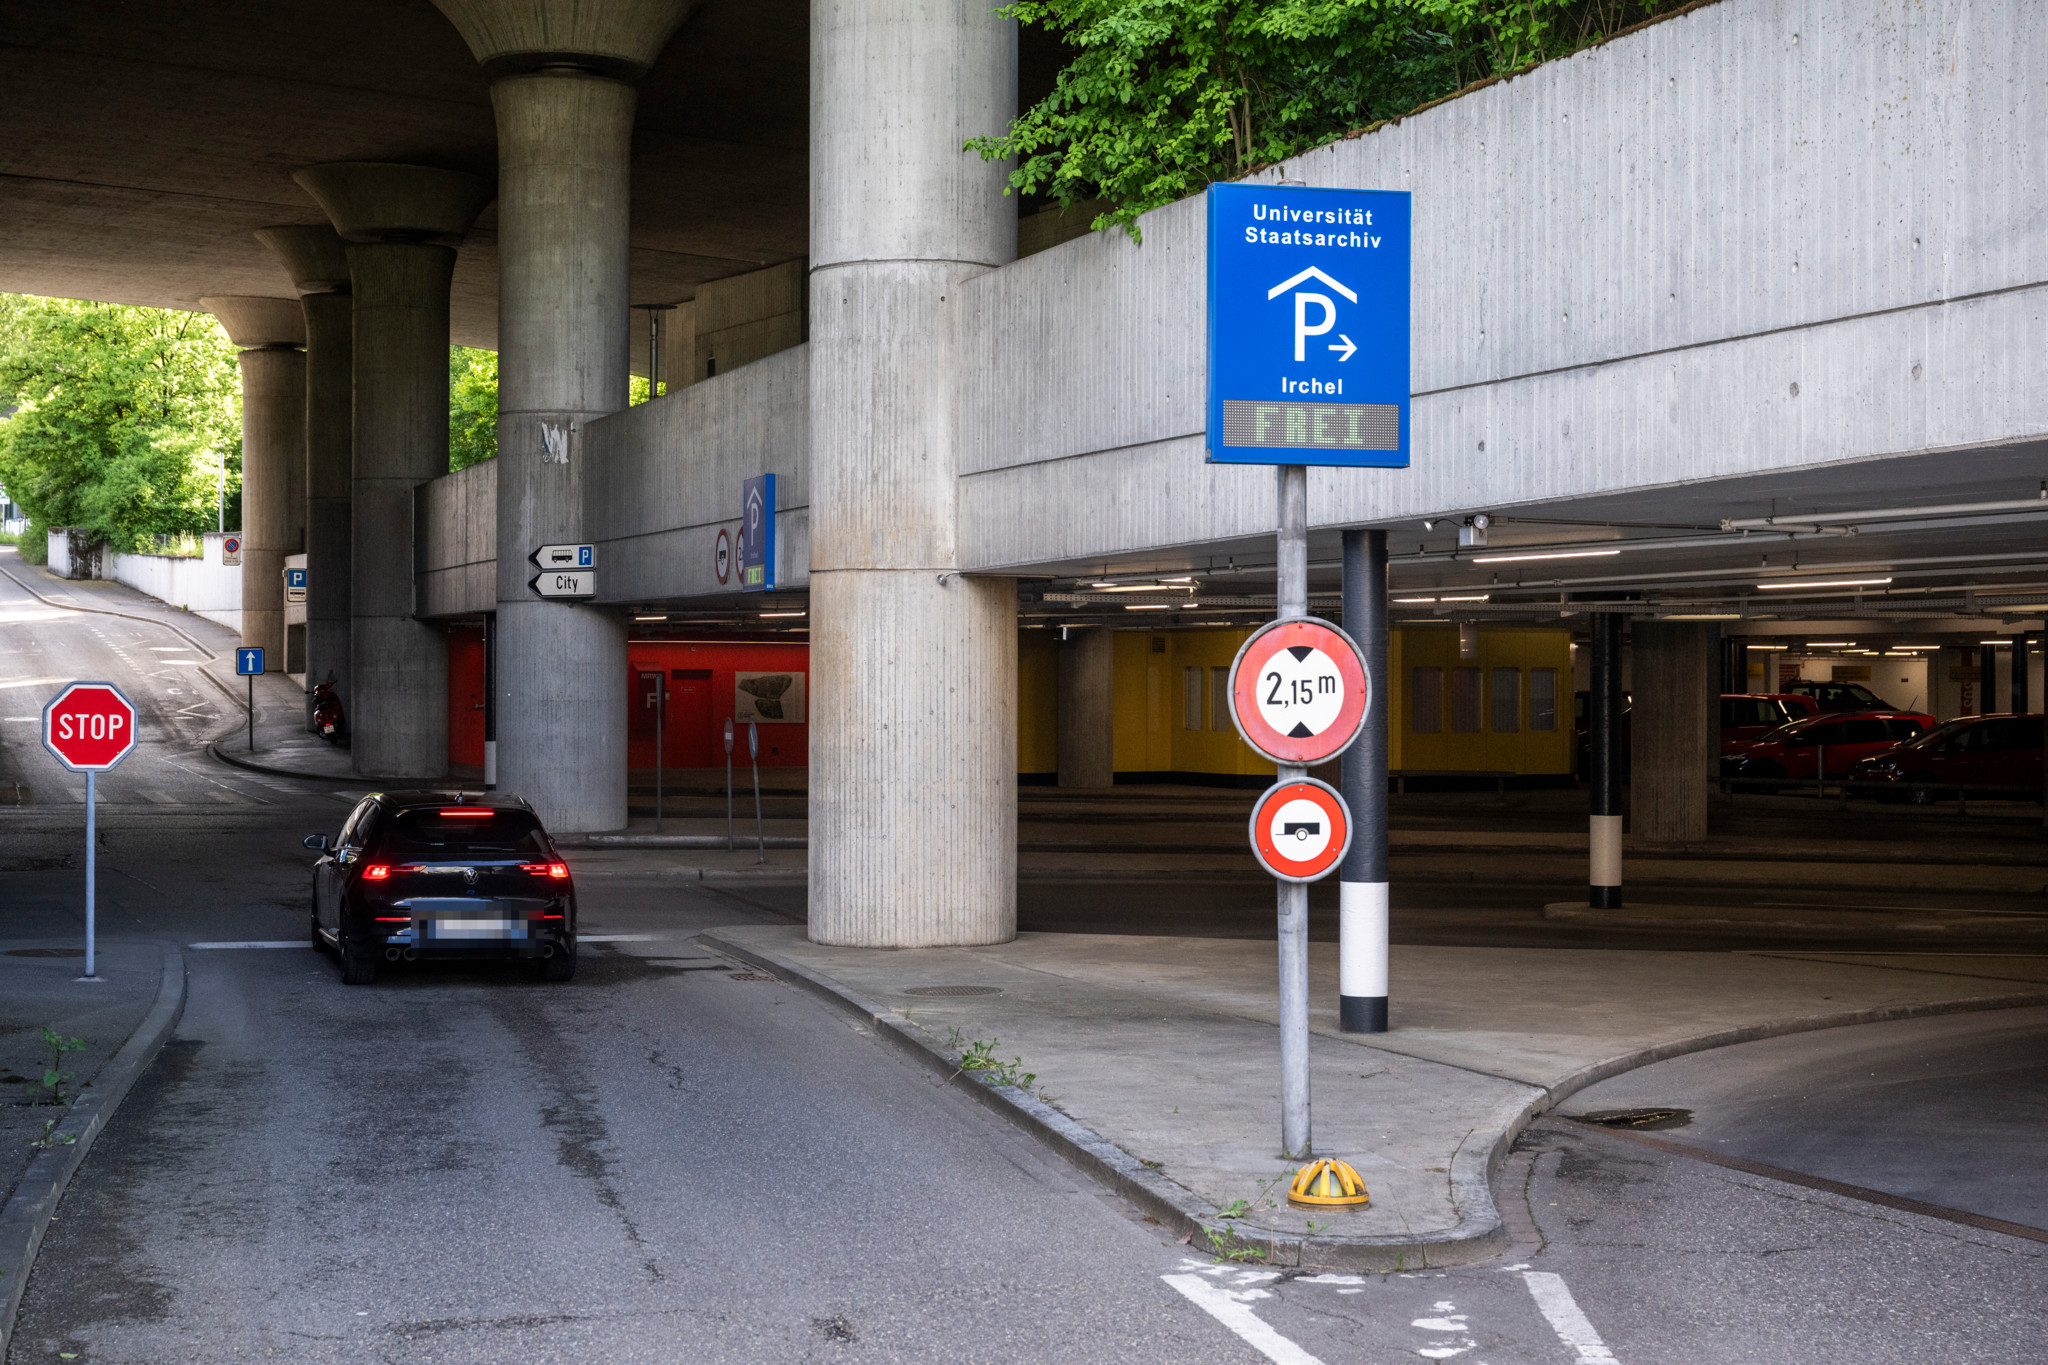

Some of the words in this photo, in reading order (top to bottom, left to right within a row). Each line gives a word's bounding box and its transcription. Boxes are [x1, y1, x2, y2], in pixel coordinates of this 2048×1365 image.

[1253, 204, 1373, 226] Universität
[1245, 227, 1382, 249] Staatsarchiv
[1294, 292, 1337, 362] P
[1281, 377, 1343, 395] Irchel
[1255, 406, 1364, 445] FREI
[751, 503, 759, 546] P
[582, 549, 589, 564] P
[293, 572, 303, 585] P
[556, 575, 578, 593] City
[59, 713, 124, 740] STOP
